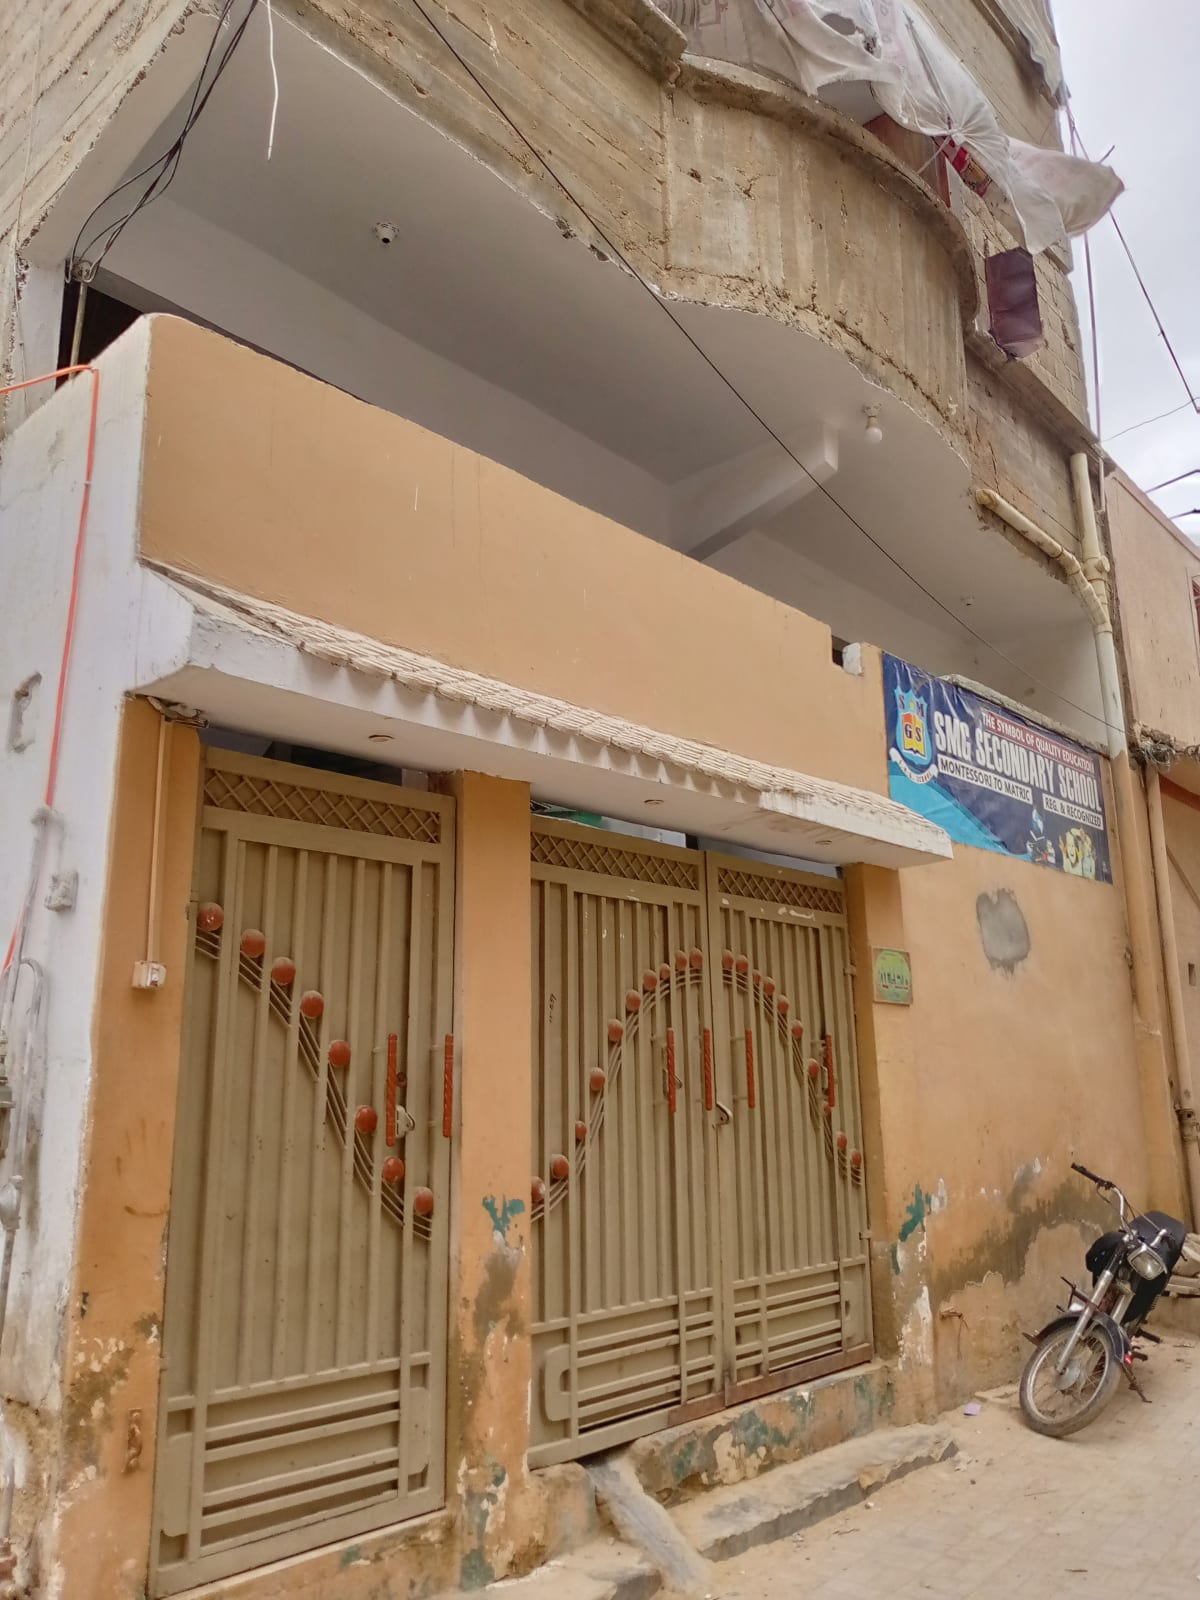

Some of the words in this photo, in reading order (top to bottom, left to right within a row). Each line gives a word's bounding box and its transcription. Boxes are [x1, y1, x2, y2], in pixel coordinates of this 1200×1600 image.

[904, 723, 913, 739] G
[915, 726, 922, 742] S
[981, 711, 996, 731] THE
[996, 718, 1025, 744] SYMBOL
[1025, 732, 1035, 748] OF
[1035, 736, 1061, 759] QUALITY
[1062, 748, 1095, 774] EDUCATION
[934, 711, 972, 763] SMG
[975, 727, 1055, 794] SECONDARY
[1057, 763, 1102, 812] SCHOOL
[940, 758, 993, 788] MONTESSORI
[993, 775, 1003, 791] TO
[1004, 782, 1030, 802] MATRIC
[1044, 796, 1059, 813] REG.
[1066, 803, 1102, 828] RECOGNIZED
